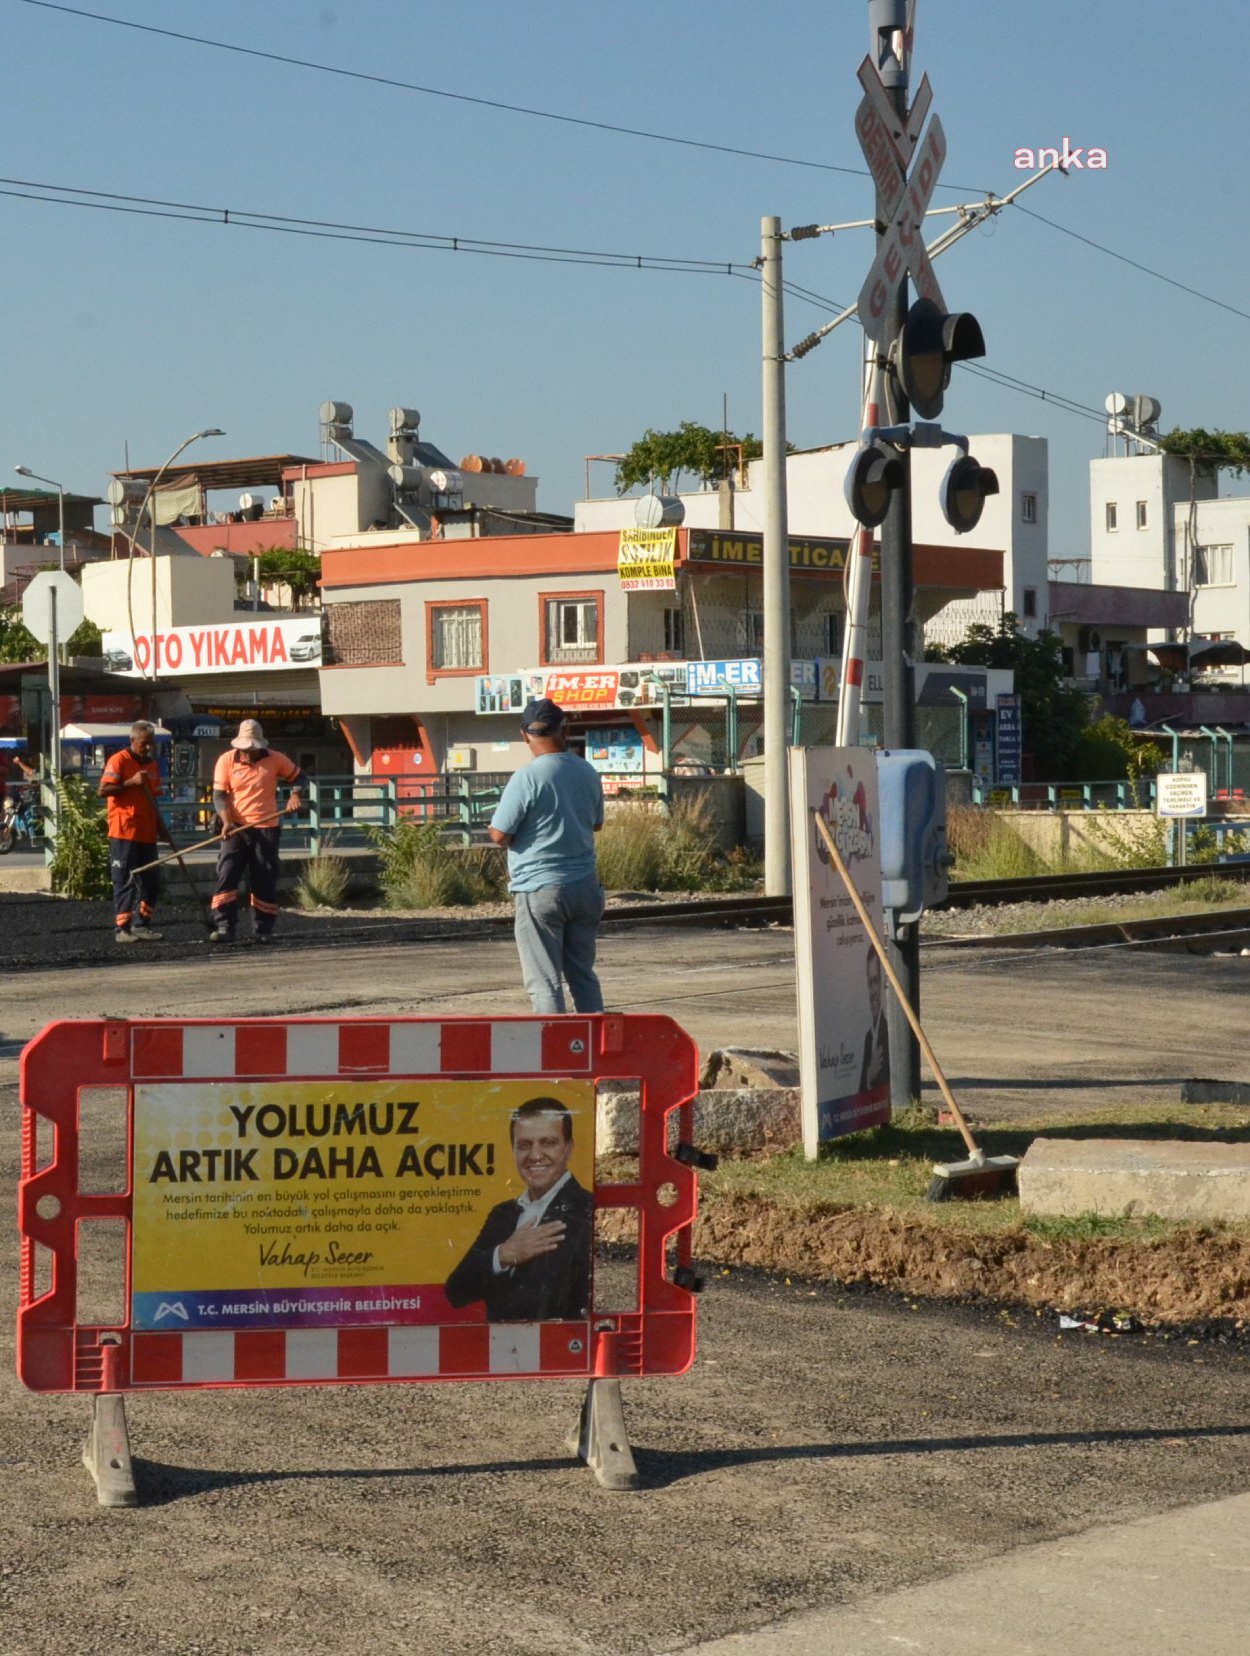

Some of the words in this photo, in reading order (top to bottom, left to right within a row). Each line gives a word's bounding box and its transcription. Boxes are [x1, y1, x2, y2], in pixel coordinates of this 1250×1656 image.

[711, 536, 762, 560] İME
[620, 566, 652, 579] KOMPLE
[133, 633, 183, 670] OTO
[188, 626, 288, 667] YIKAMA
[548, 674, 616, 691] İM-ER
[553, 688, 609, 702] SHOP
[1000, 710, 1012, 720] EV
[229, 1101, 421, 1138] YOLUMUZ
[148, 1147, 260, 1184] ARTIK
[273, 1145, 384, 1181] DAHA
[395, 1143, 496, 1180] AÇIK!
[162, 1193, 201, 1204] Mersin
[205, 1191, 254, 1203] tarihinin
[257, 1192, 272, 1202] en
[275, 1190, 310, 1204] büyük
[313, 1189, 330, 1202] yol
[333, 1188, 396, 1202] çalışmasını
[399, 1186, 482, 1201] gerçekleştirme
[166, 1209, 230, 1220] hedefimize
[233, 1207, 248, 1219] bu
[251, 1206, 308, 1219] noktadaki
[311, 1204, 371, 1219] çalışmayla
[374, 1203, 404, 1216] daha
[407, 1203, 422, 1215] da
[425, 1201, 477, 1216] yaklaştık.
[244, 1223, 292, 1235] Yolumuz
[295, 1221, 321, 1234] artık
[324, 1220, 354, 1233] daha
[357, 1220, 372, 1232] da
[375, 1218, 401, 1234] açık.
[259, 1240, 320, 1278] Vahap
[197, 1304, 219, 1316] T.C.
[221, 1300, 270, 1315] MERSİN
[273, 1298, 352, 1316] BÜYÜKŞEHİR
[354, 1295, 421, 1311] BELEDİYESİ
